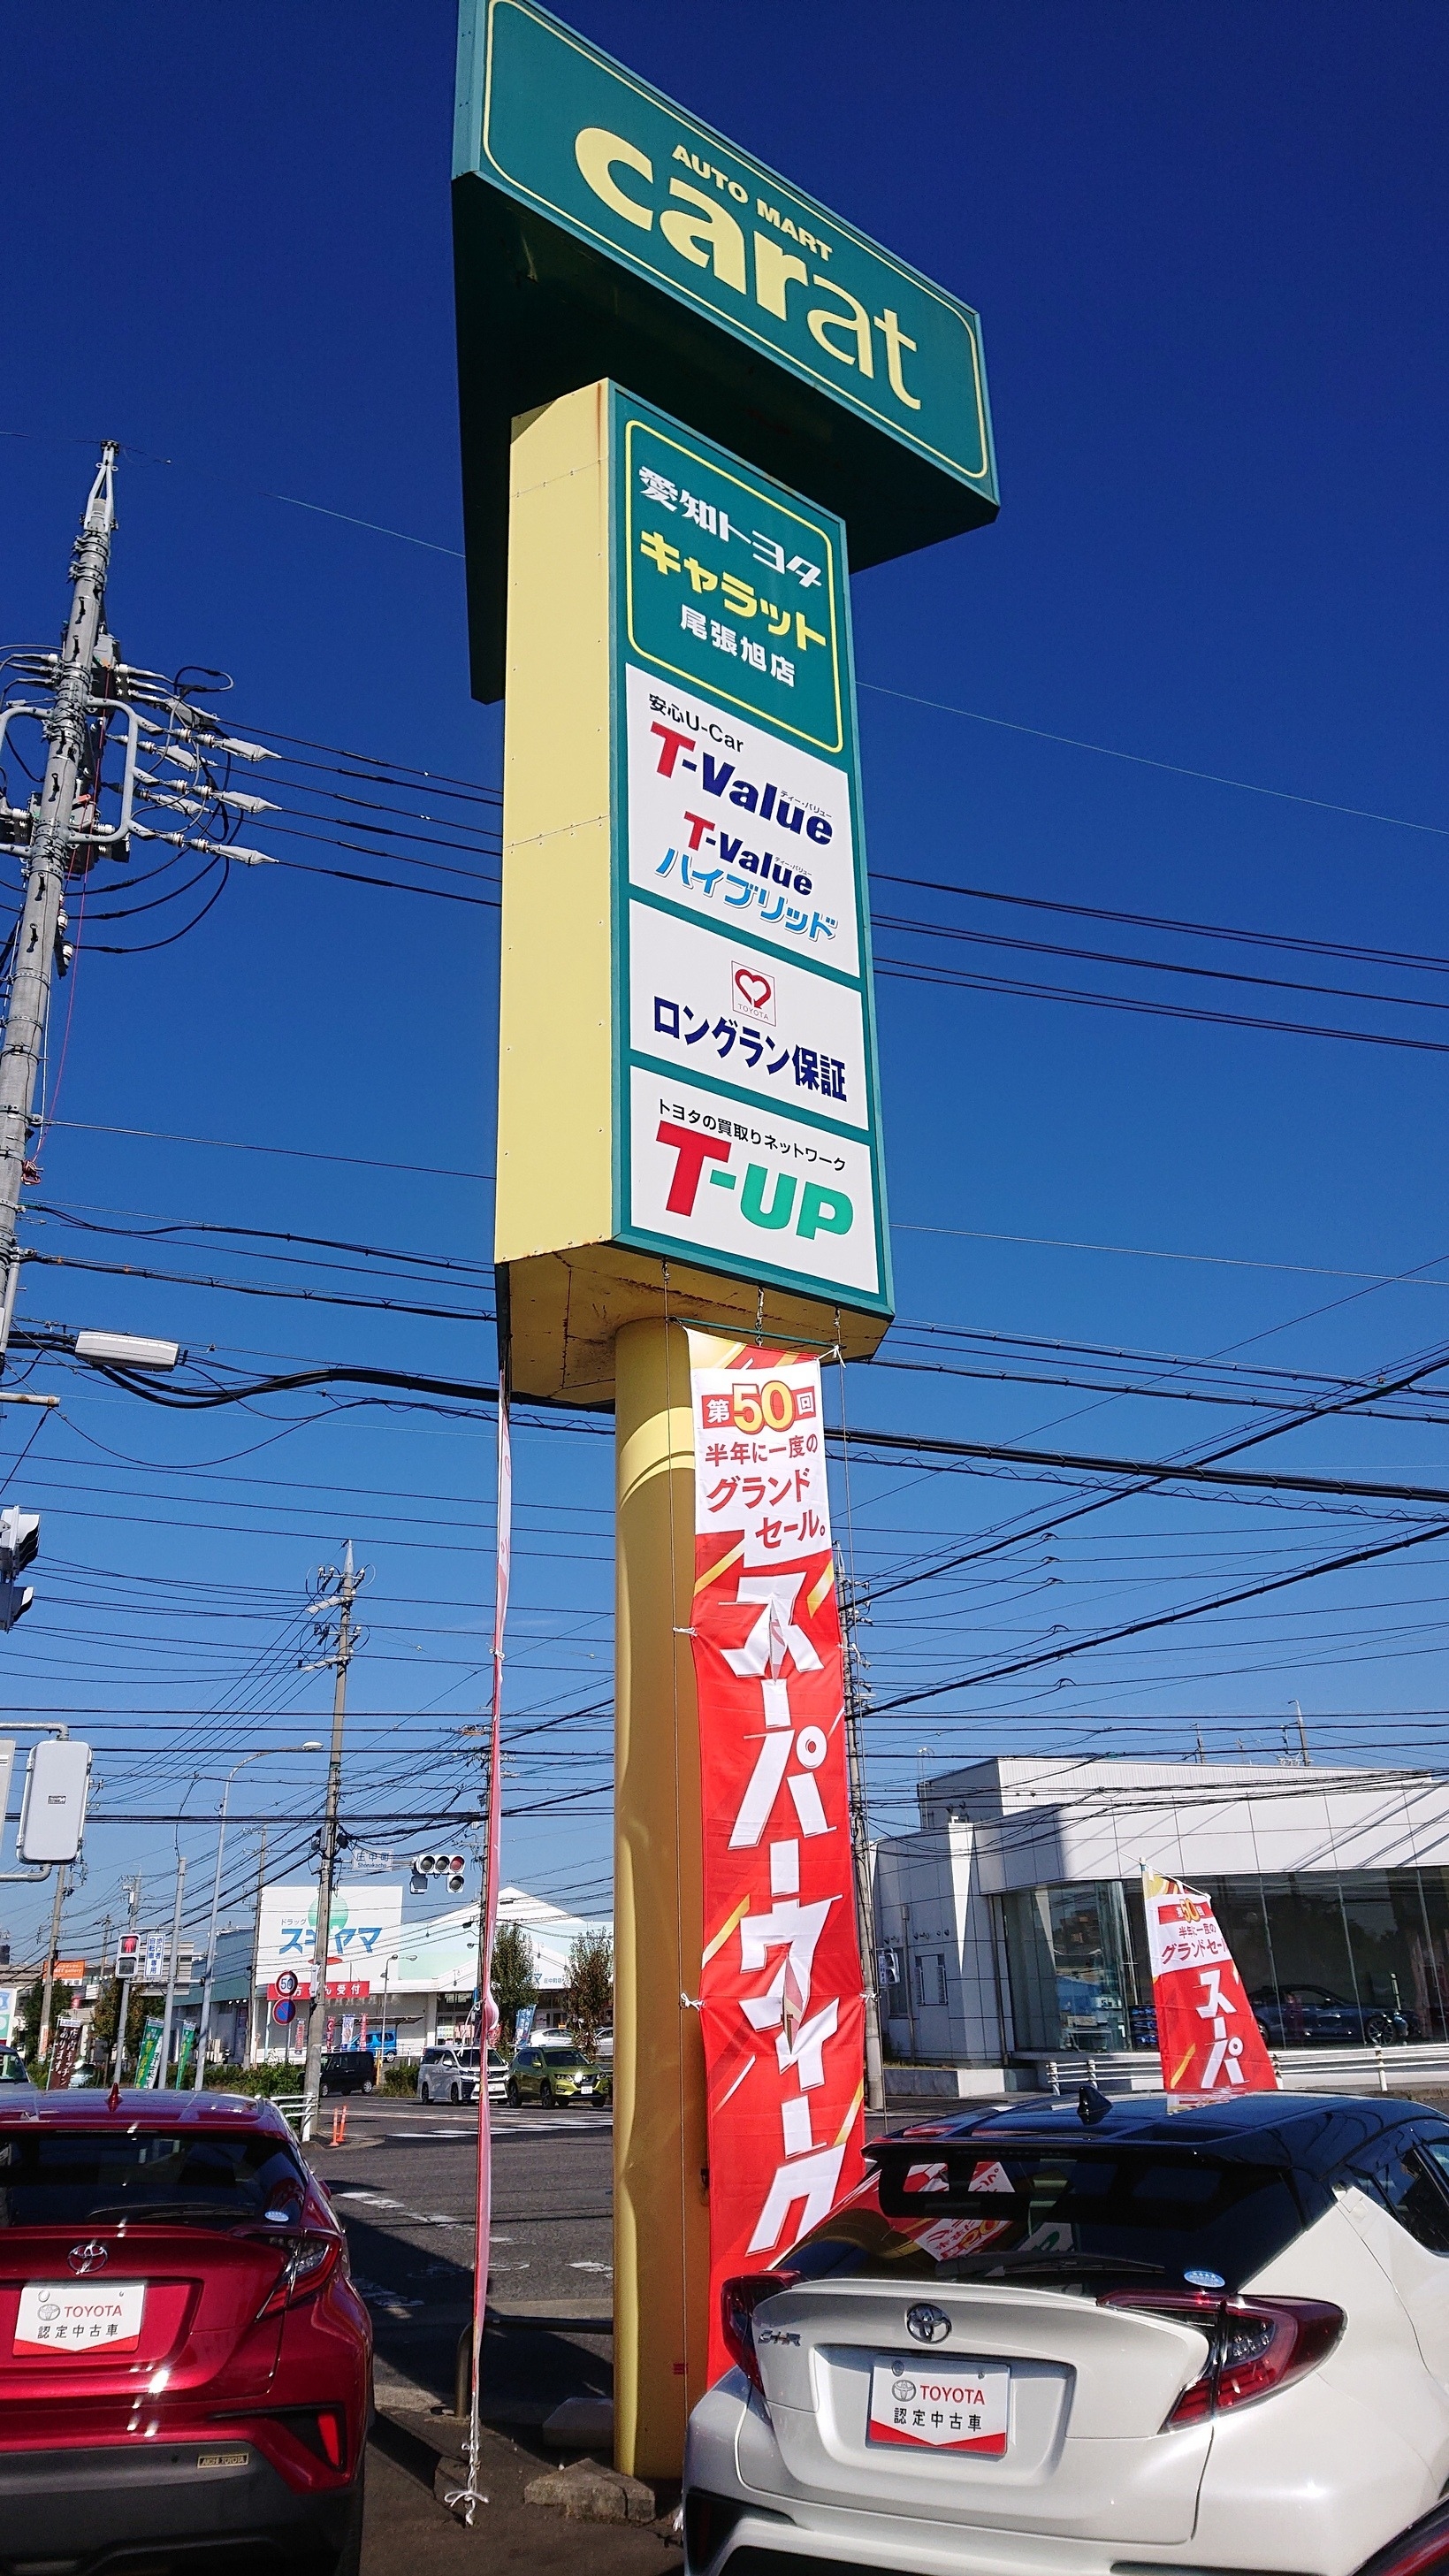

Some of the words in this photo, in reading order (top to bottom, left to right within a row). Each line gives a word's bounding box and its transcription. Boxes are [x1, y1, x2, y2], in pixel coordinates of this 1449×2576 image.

[672, 144, 749, 203] AUTO
[756, 198, 833, 261] MART
[575, 127, 921, 410] carat
[638, 466, 823, 588] 愛知トヨタ
[640, 531, 827, 651] キャラット
[680, 604, 795, 688] 尾張旭店
[649, 693, 744, 753] 安心U-Car
[650, 721, 833, 845] T-Value
[683, 811, 812, 896] T-Value
[655, 847, 838, 941] ハイブリッド
[653, 996, 847, 1102] ロングラン保証
[737, 1003, 769, 1020] TOYOTA
[659, 1099, 846, 1172] トヨタの買取りネットワーク
[656, 1120, 853, 1240] T-UP
[706, 1380, 815, 1434] 第50回
[705, 1433, 818, 1467] 半年に一度の
[706, 1468, 810, 1513] グランド
[719, 1571, 846, 2256] スーパーウィーク
[280, 1977, 294, 1990] 50
[37, 2324, 118, 2339] 認定中古車
[64, 2305, 123, 2318] TOYOTA
[894, 2407, 982, 2432] 認定中古車
[919, 2384, 986, 2405] TOYOTA
